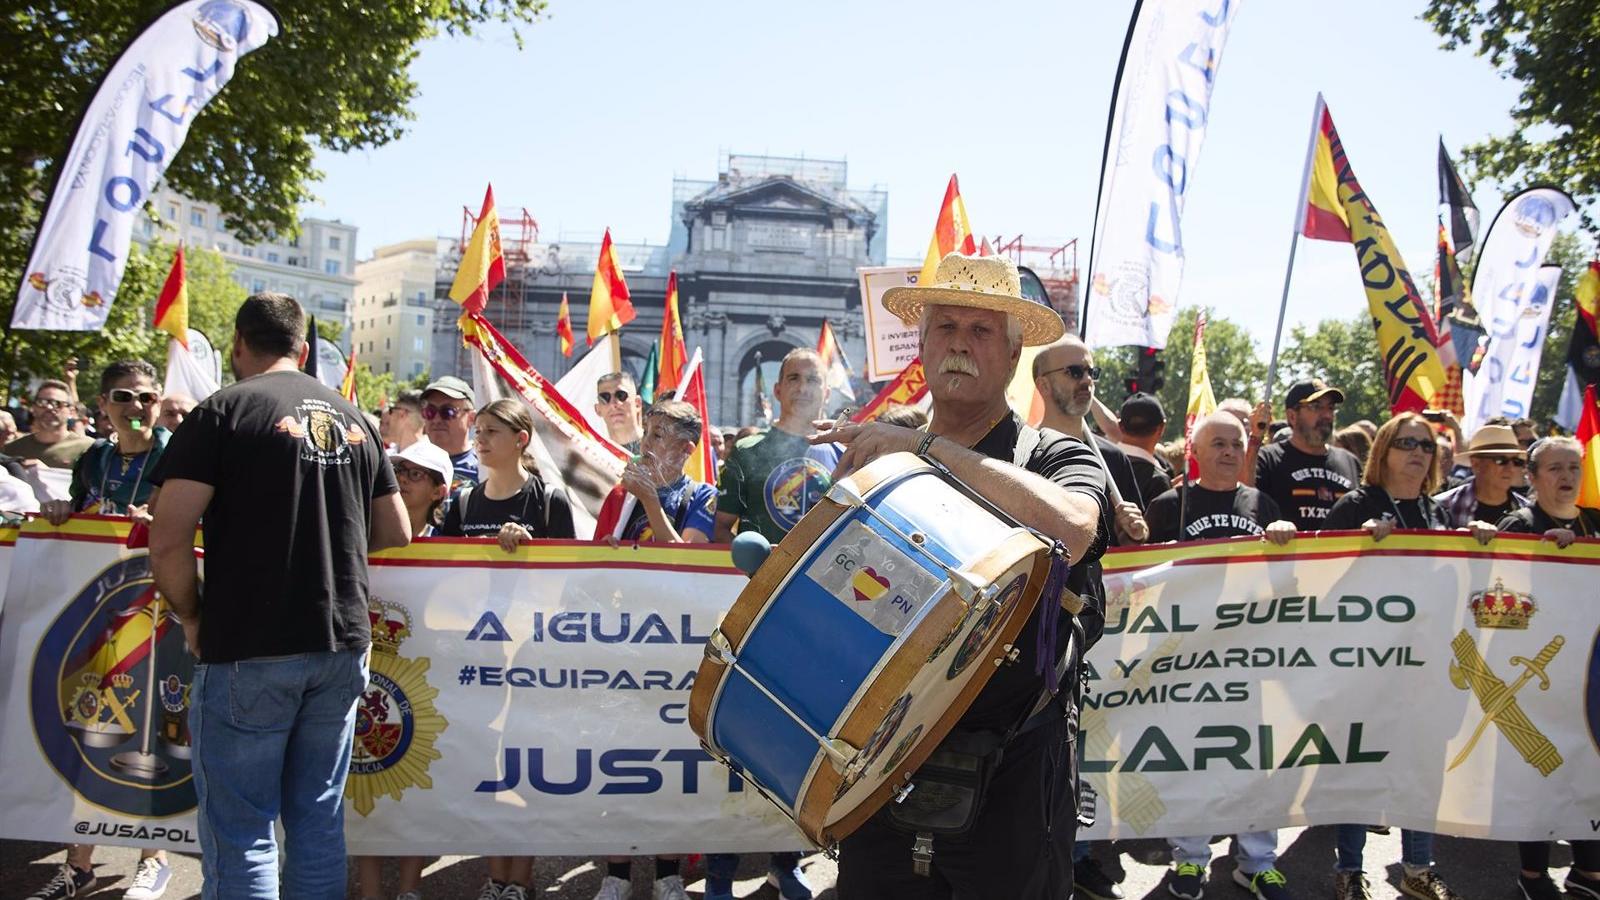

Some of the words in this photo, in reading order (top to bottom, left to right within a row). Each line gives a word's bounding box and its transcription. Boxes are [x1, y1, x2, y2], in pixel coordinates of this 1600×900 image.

[1186, 516, 1213, 536] QUE
[1211, 514, 1229, 527] TE
[1230, 515, 1264, 535] VOTE
[835, 553, 856, 572] GC
[891, 595, 913, 614] PN
[465, 611, 513, 641] A
[533, 611, 713, 644] IGUAL
[1214, 595, 1416, 631] SUELDO
[1115, 659, 1142, 679] Y
[1151, 647, 1317, 674] GUARDIA
[1329, 646, 1427, 668] CIVIL
[1080, 681, 1250, 712] NOMICAS
[473, 747, 744, 796] JUSTI
[1079, 722, 1391, 773] LARIAL
[74, 821, 198, 843] @JUSAPOL
